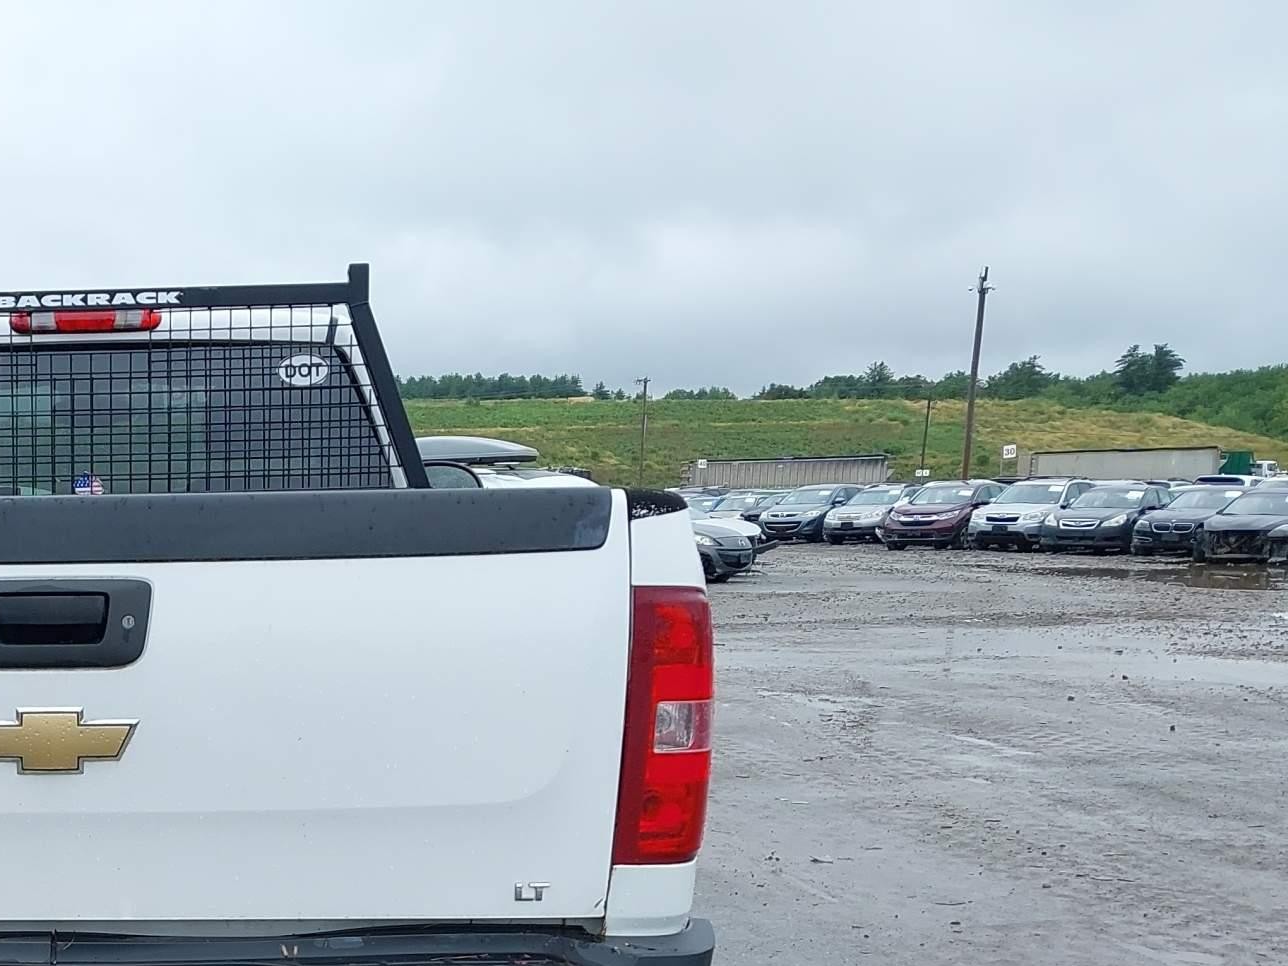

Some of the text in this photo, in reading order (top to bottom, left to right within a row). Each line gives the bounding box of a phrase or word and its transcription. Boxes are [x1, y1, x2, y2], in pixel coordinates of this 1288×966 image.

[285, 362, 323, 379] DOT
[1004, 447, 1016, 456] 30
[514, 881, 551, 901] LT
